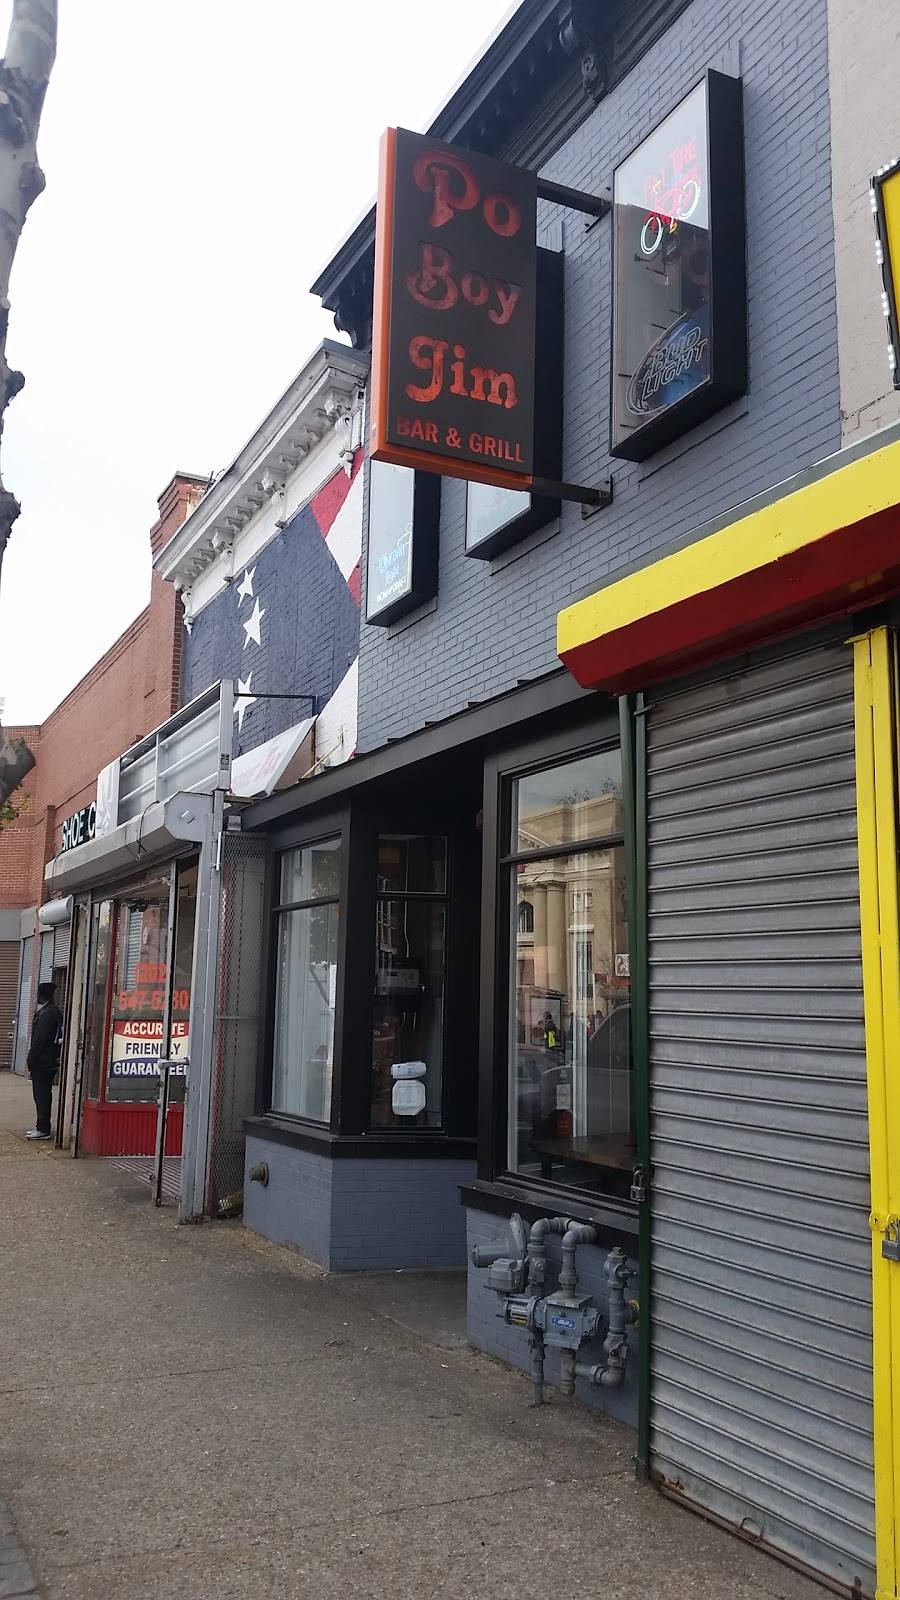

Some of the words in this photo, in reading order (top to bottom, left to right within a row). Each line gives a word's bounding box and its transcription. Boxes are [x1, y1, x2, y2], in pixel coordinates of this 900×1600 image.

[411, 149, 521, 238] Po
[405, 240, 525, 326] Boy
[404, 334, 520, 409] Jim
[641, 338, 708, 401] LIGHT
[652, 326, 702, 377] BUD
[396, 415, 439, 443] BAR
[446, 426, 461, 449] &
[469, 433, 525, 464] GRILL
[62, 808, 85, 851] SHOE
[123, 1022, 185, 1036] ACCURTE
[125, 1042, 181, 1055] FRIENY
[113, 1062, 188, 1076] GUARANEE
